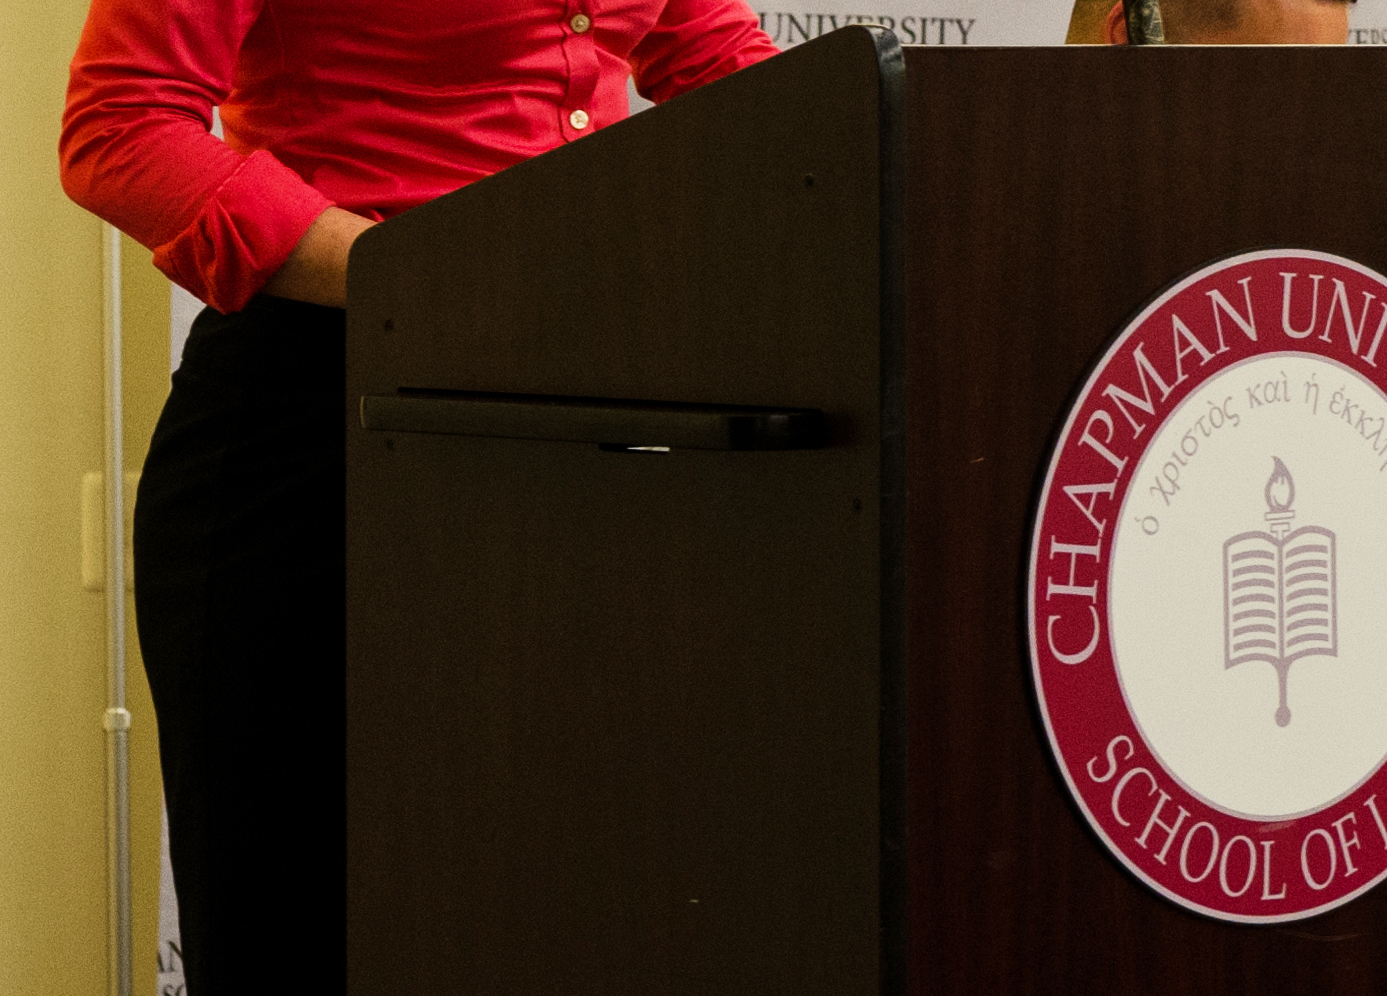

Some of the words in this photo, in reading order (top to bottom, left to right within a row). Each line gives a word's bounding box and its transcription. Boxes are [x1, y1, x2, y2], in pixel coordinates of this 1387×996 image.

[1046, 276, 1259, 665] CHAPMAN
[1087, 734, 1286, 901] SCHOOL
[1300, 811, 1363, 891] OF
